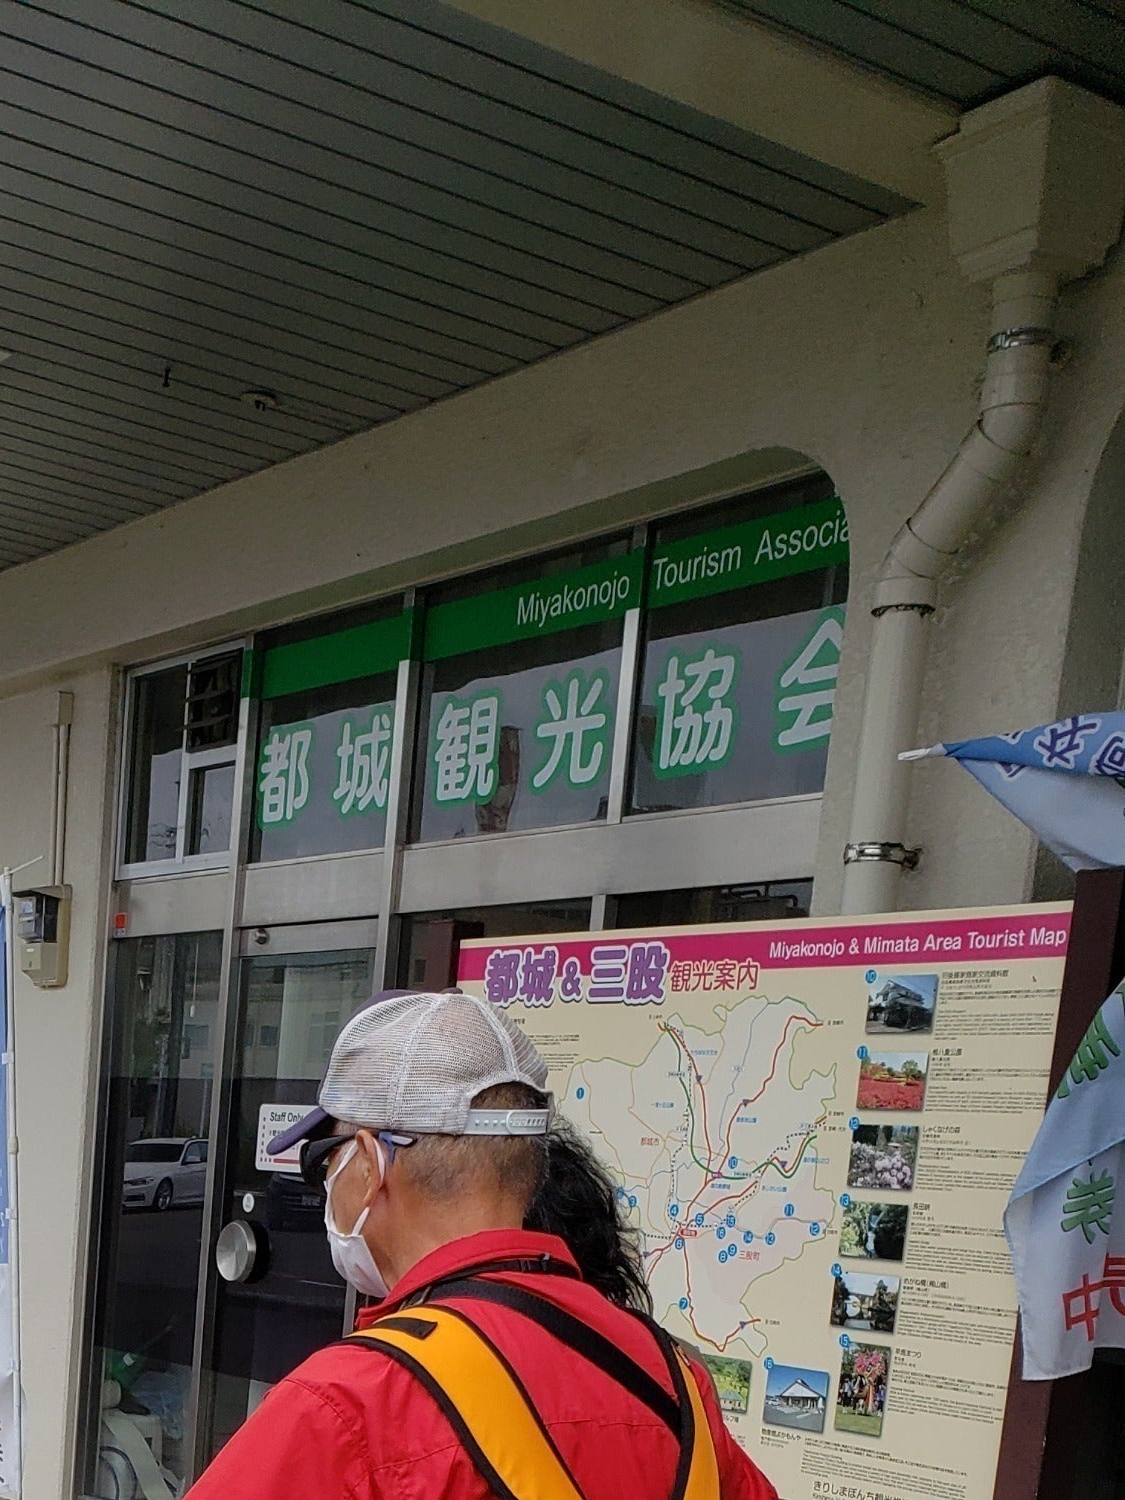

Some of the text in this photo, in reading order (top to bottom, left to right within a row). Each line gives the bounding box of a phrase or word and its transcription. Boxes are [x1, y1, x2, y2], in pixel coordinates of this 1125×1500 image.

[517, 571, 630, 628] Miyakonojo
[653, 545, 742, 590] Tourism
[260, 617, 844, 823] 都城観光協会
[769, 927, 1067, 960] Miyakonojo & Mimata Area Tourist Map
[485, 948, 557, 1005] 都城
[587, 944, 668, 1002] 三股
[670, 958, 761, 992] 観光案内
[269, 1112, 287, 1122] Staff
[738, 1251, 760, 1261] 三股町
